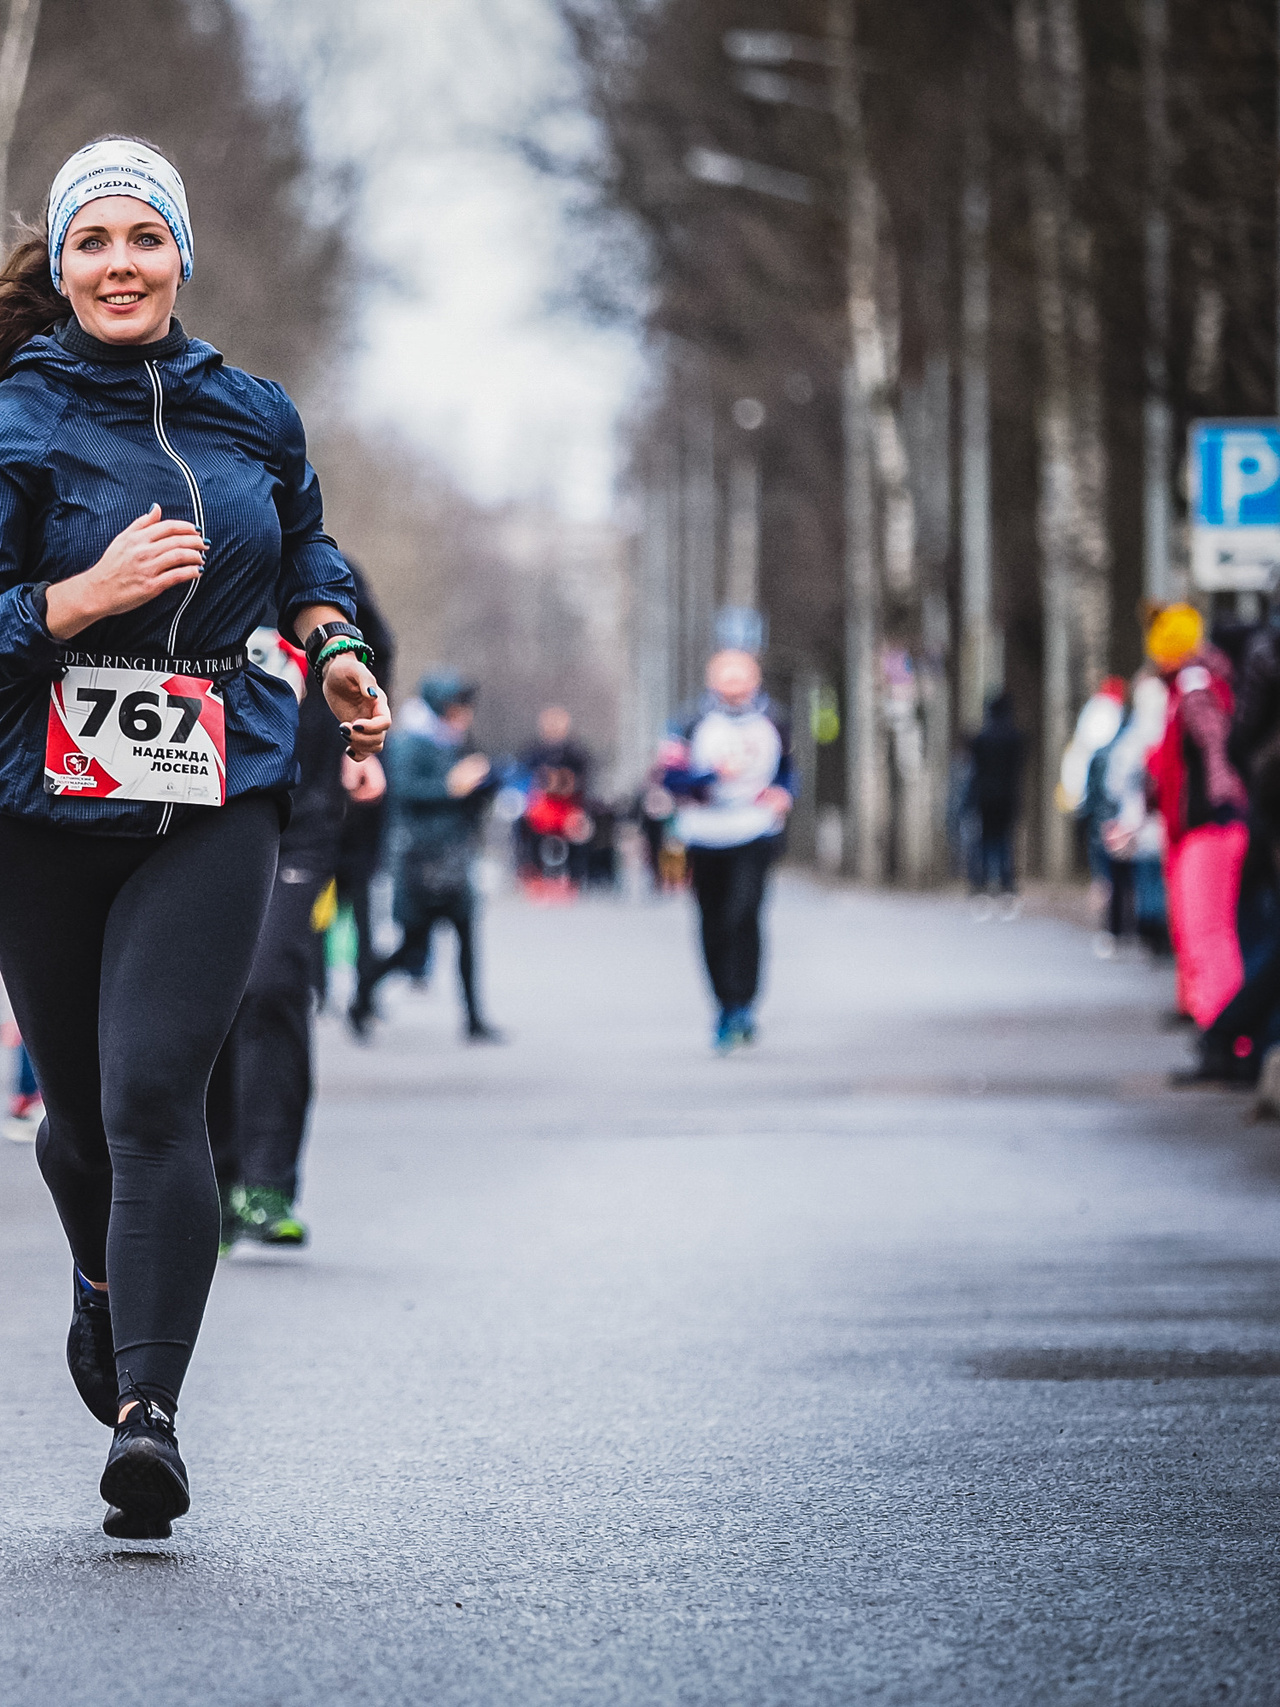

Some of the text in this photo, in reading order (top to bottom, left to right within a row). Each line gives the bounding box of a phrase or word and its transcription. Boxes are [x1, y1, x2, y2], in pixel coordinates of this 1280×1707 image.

[1221, 432, 1279, 526] P
[55, 650, 97, 667] DEN
[102, 654, 146, 670] RING
[152, 658, 202, 674] ULTRA
[204, 656, 234, 673] TRAIL
[76, 687, 203, 744] 767
[132, 746, 210, 763] НАДЕЖДА
[150, 761, 210, 776] ЛОСЕВА
